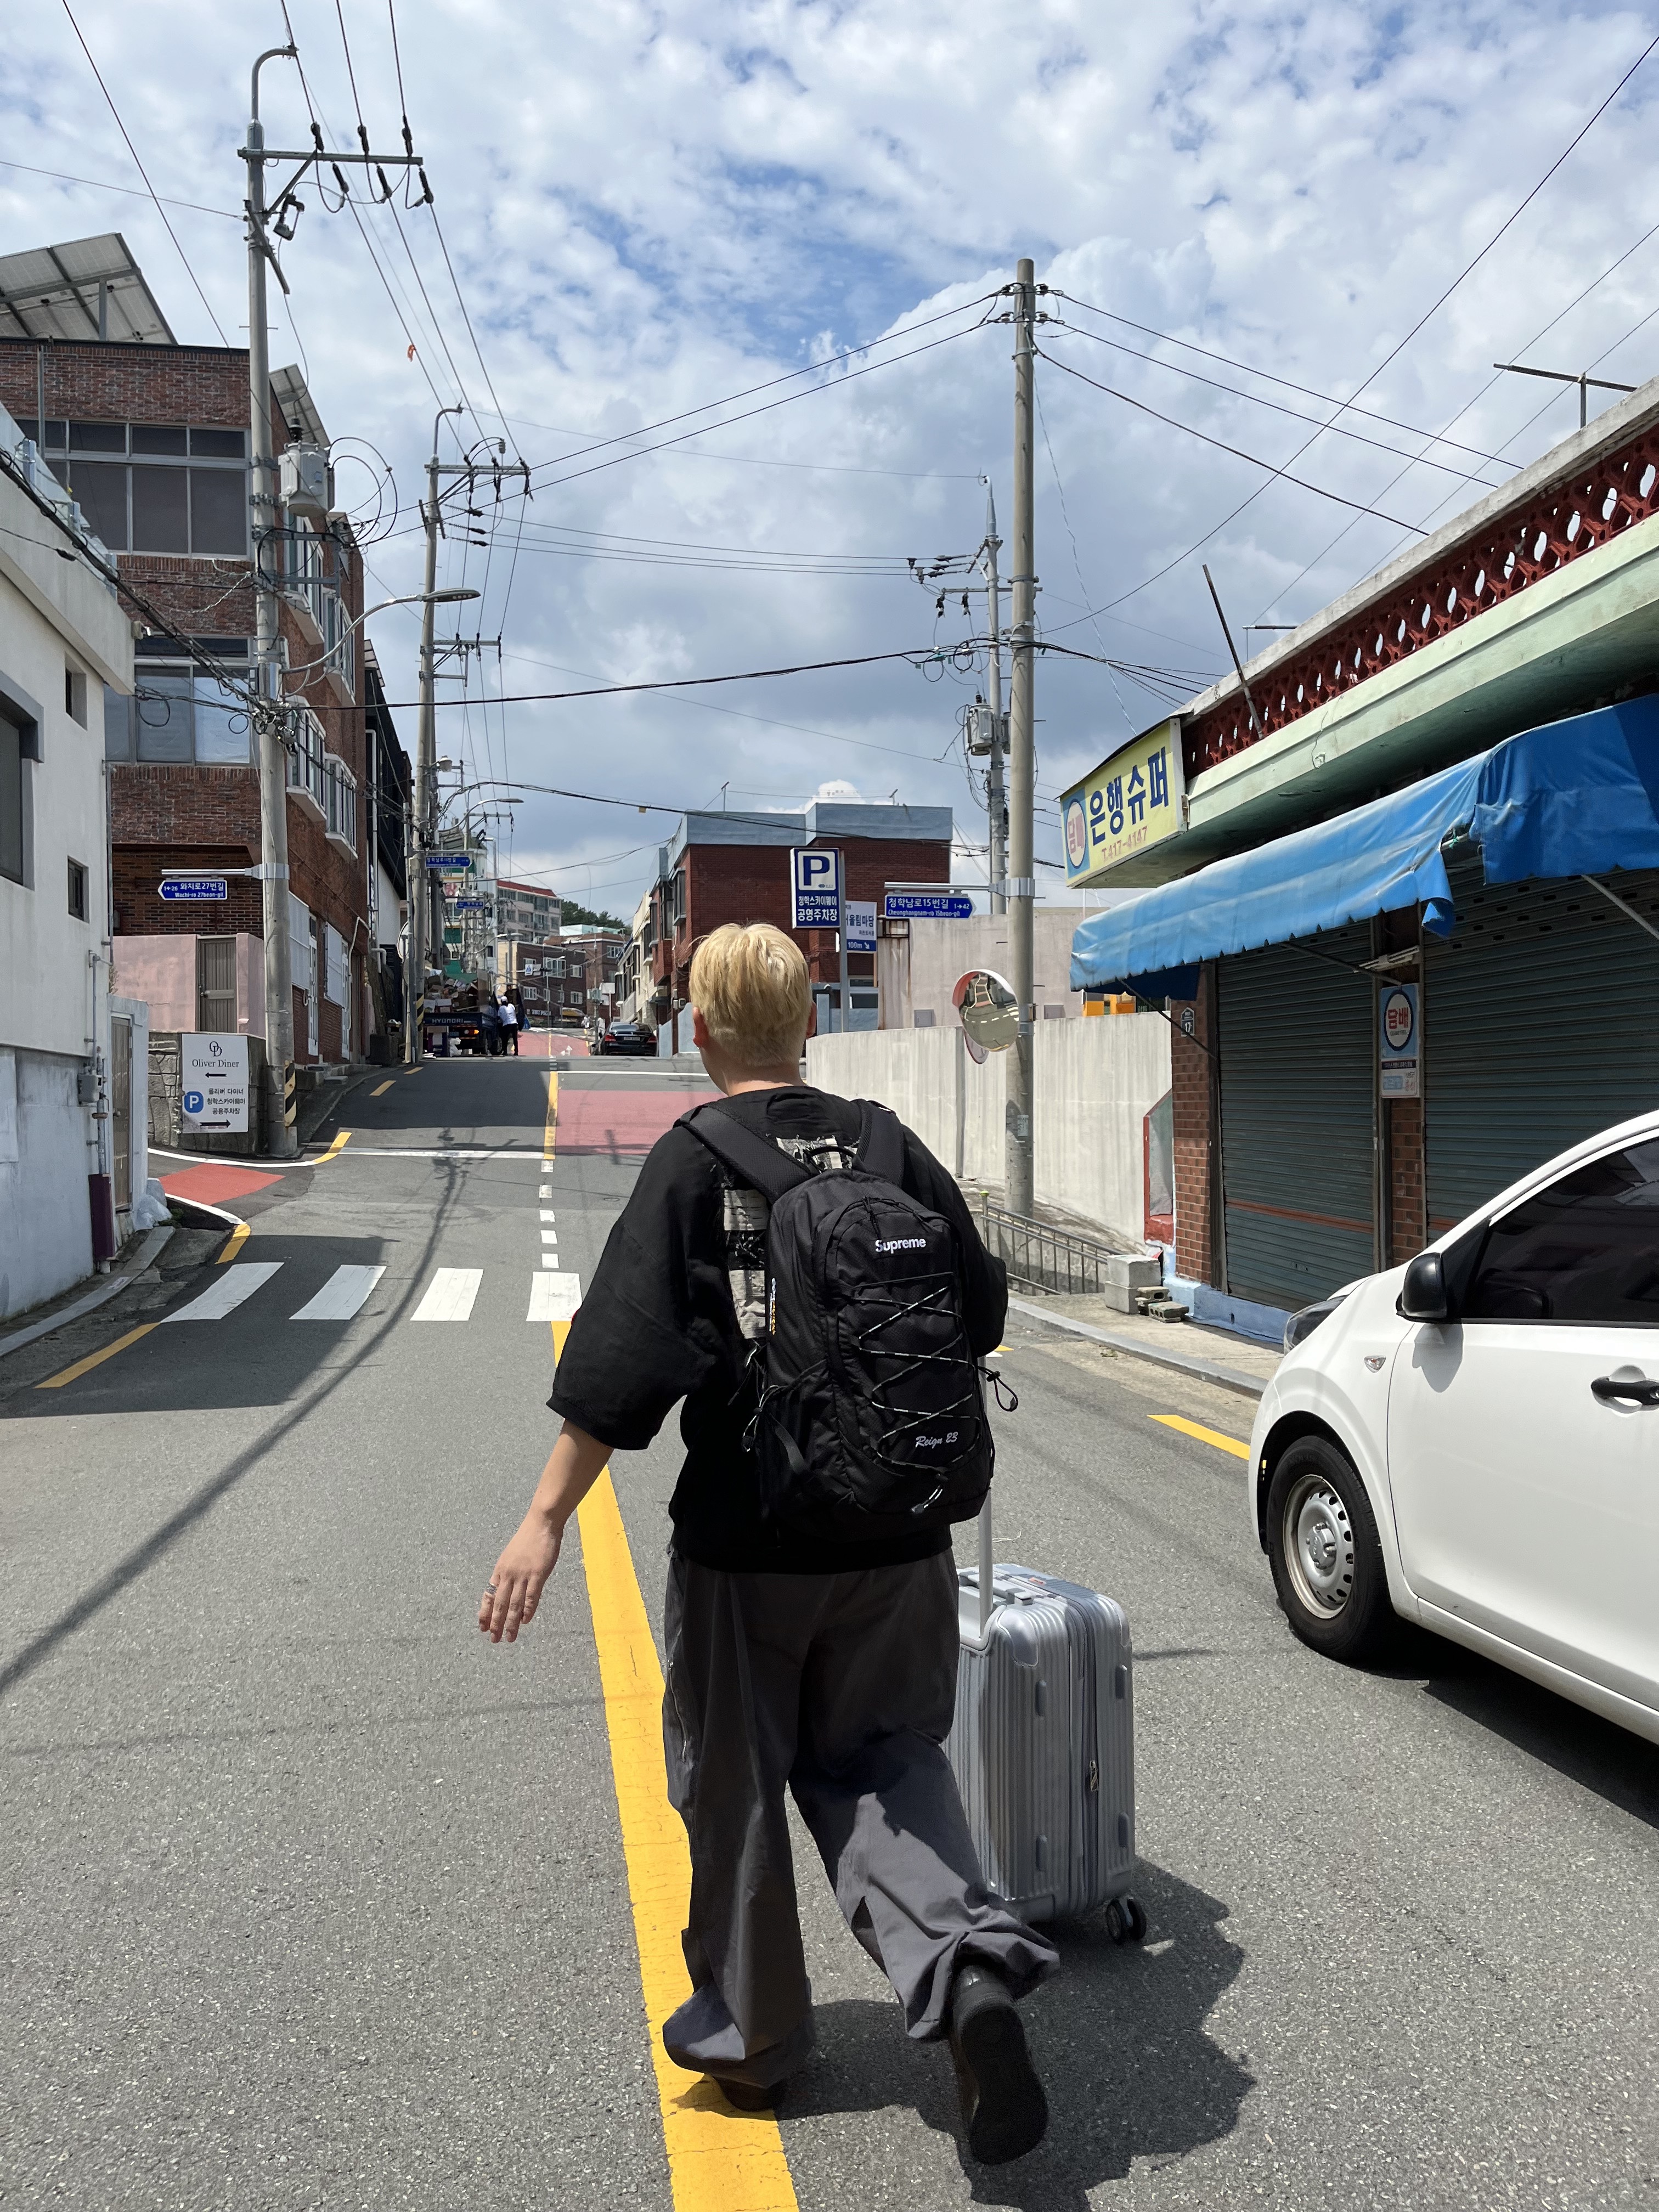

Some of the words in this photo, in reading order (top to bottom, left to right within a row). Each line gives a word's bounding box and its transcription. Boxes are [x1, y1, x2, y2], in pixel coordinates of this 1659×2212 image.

[1090, 747, 1169, 846] 은행슈퍼
[803, 855, 830, 886] P
[180, 882, 224, 891] 와치로27번길
[798, 896, 837, 906] 청학스카이웨이
[888, 898, 949, 909] 청학남로15번길
[798, 909, 838, 921] 공영주차장
[1388, 1007, 1409, 1029] 담배
[192, 1059, 216, 1068] Oliver
[218, 1059, 240, 1068] Diner
[189, 1095, 199, 1109] P
[875, 1238, 927, 1254] Supreme
[915, 1435, 943, 1449] Reign
[945, 1431, 958, 1443] 23
